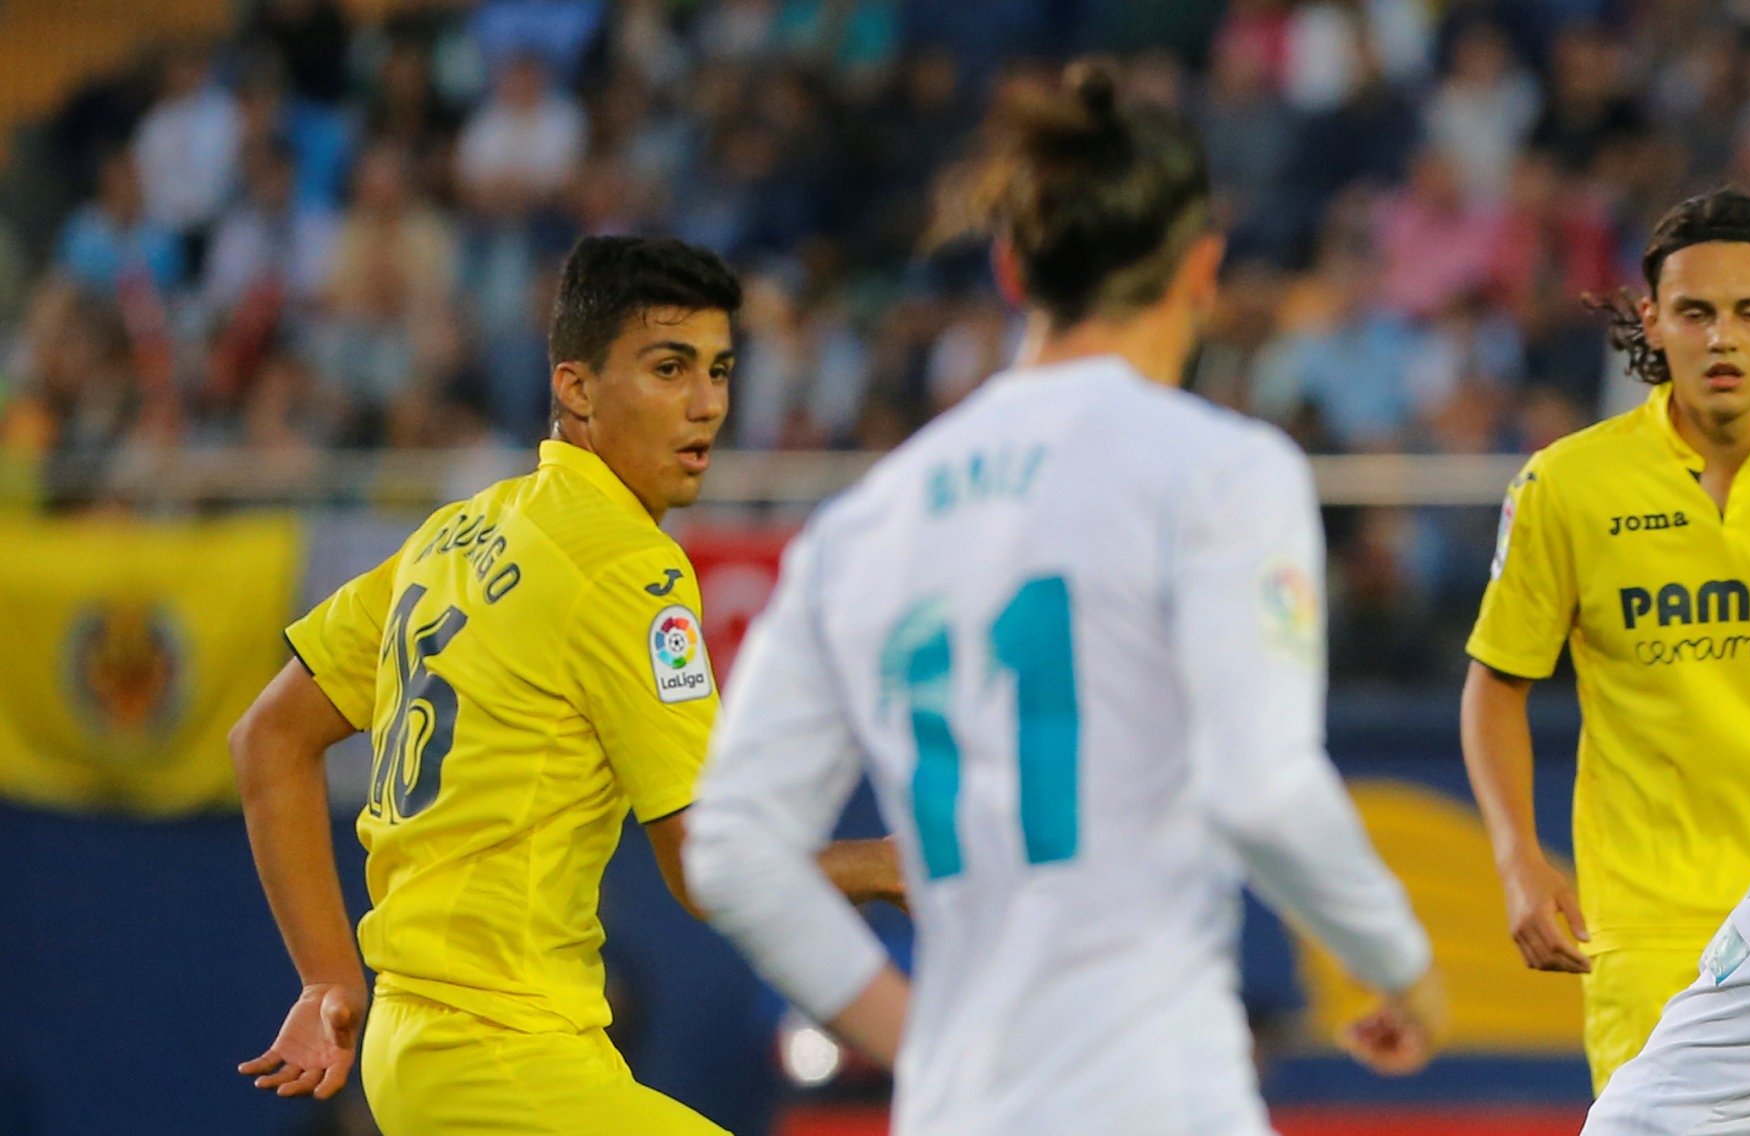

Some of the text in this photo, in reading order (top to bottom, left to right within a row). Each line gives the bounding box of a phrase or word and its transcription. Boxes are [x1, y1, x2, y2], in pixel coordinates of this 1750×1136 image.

[368, 582, 468, 825] 16
[660, 671, 705, 690] LaLiga
[880, 574, 1079, 879] 11
